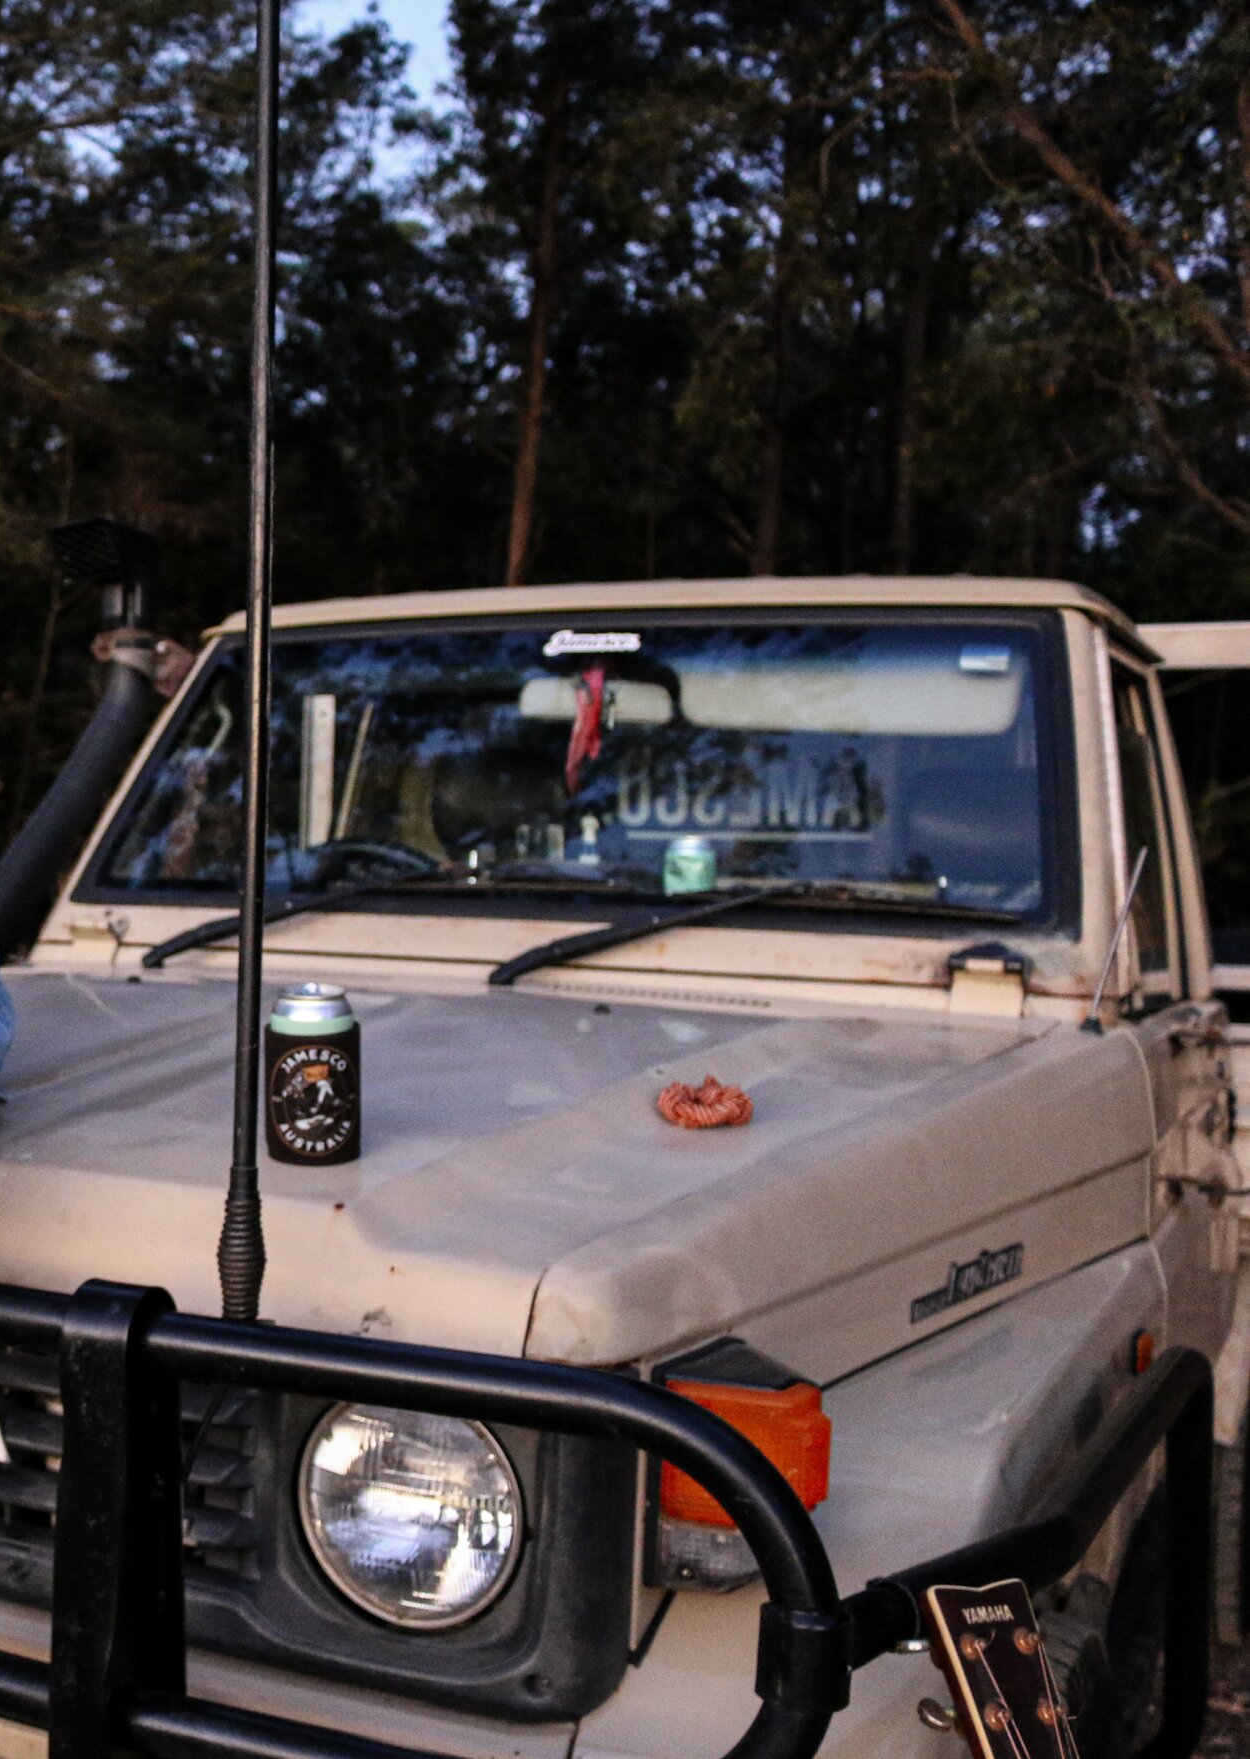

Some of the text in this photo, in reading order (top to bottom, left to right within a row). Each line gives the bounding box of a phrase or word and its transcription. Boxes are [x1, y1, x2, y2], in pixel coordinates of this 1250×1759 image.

[281, 1049, 348, 1074] JAMESCO
[279, 1120, 351, 1152] AUSTRALIA
[962, 1604, 1014, 1625] YAMAHA
